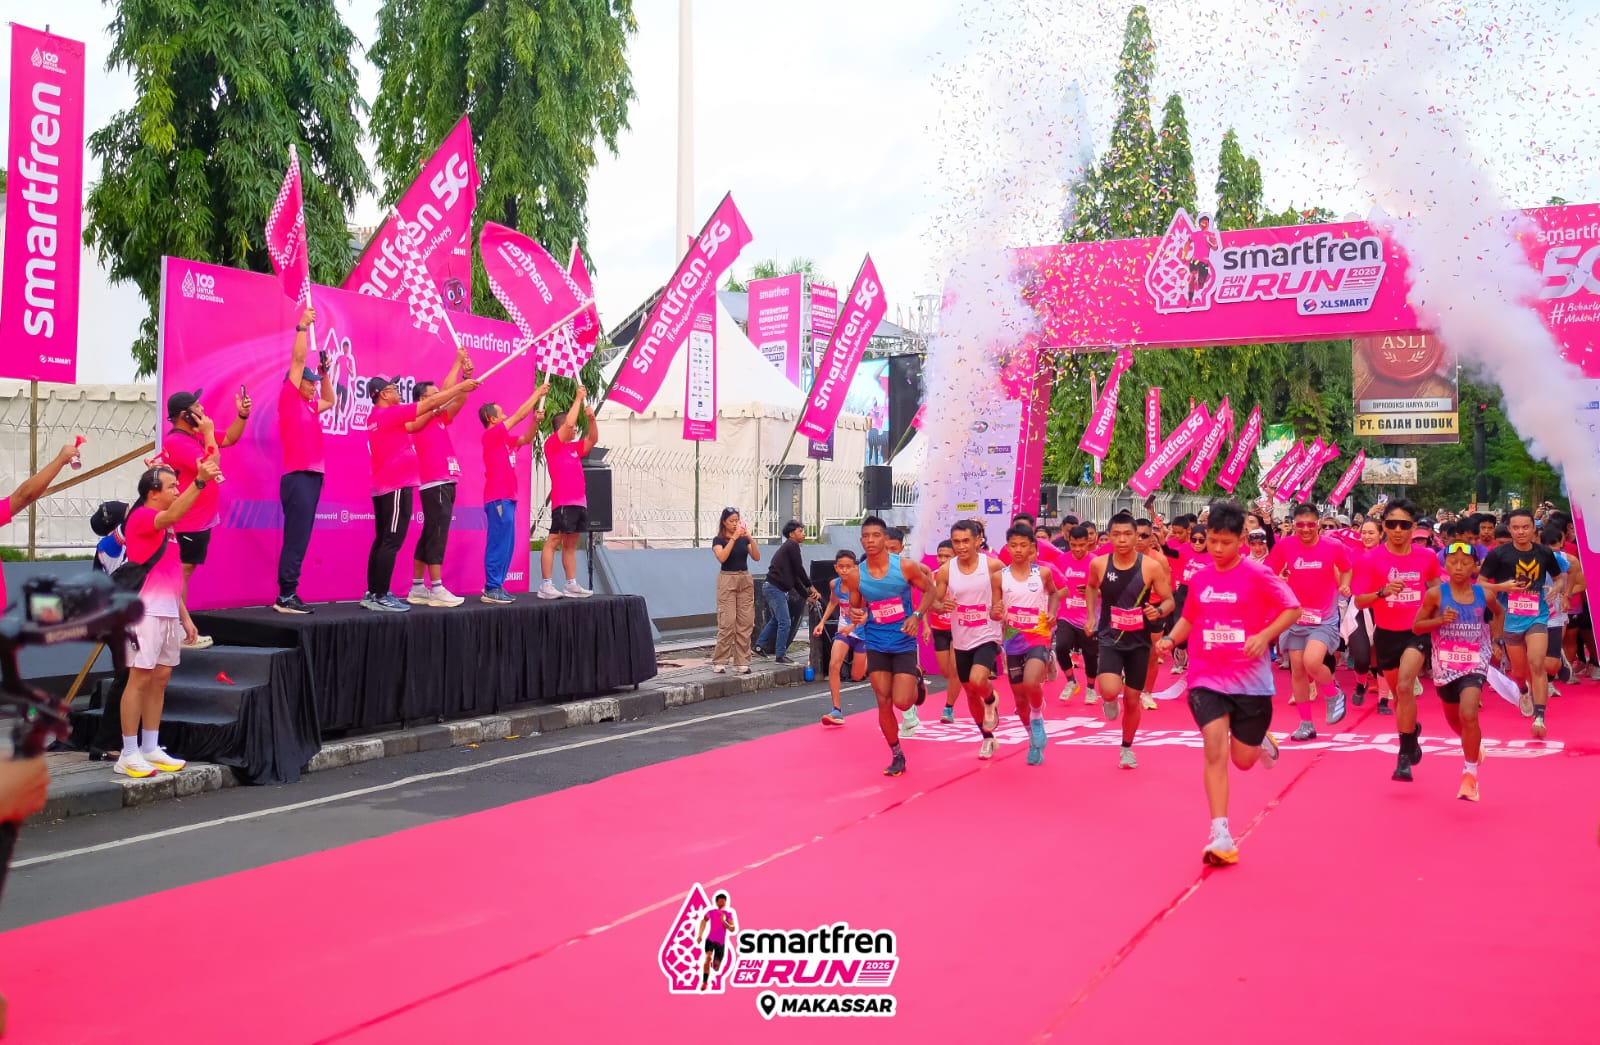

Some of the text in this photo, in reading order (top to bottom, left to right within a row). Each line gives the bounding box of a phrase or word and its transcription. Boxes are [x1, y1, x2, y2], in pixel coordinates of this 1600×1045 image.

[18, 82, 61, 338] smartfren
[358, 152, 469, 298] artfren 5G
[1223, 236, 1379, 270] smartfren
[1537, 223, 1600, 242] smartf
[632, 219, 731, 374] smartfren 5G
[1221, 286, 1239, 297] 5K
[1222, 275, 1247, 285] FUN
[1245, 268, 1346, 297] RUN
[1320, 297, 1369, 309] XLSMART
[814, 310, 864, 410] smartfren
[855, 277, 879, 312] 5G
[1381, 335, 1427, 349] ASLI
[1144, 430, 1191, 478] smartfren
[1187, 412, 1204, 433] 5G
[1147, 400, 1156, 454] artfren
[1360, 418, 1453, 430] PT. GAJAH DUDUK
[1190, 422, 1222, 474] smartfren
[1227, 425, 1254, 475] smartfren
